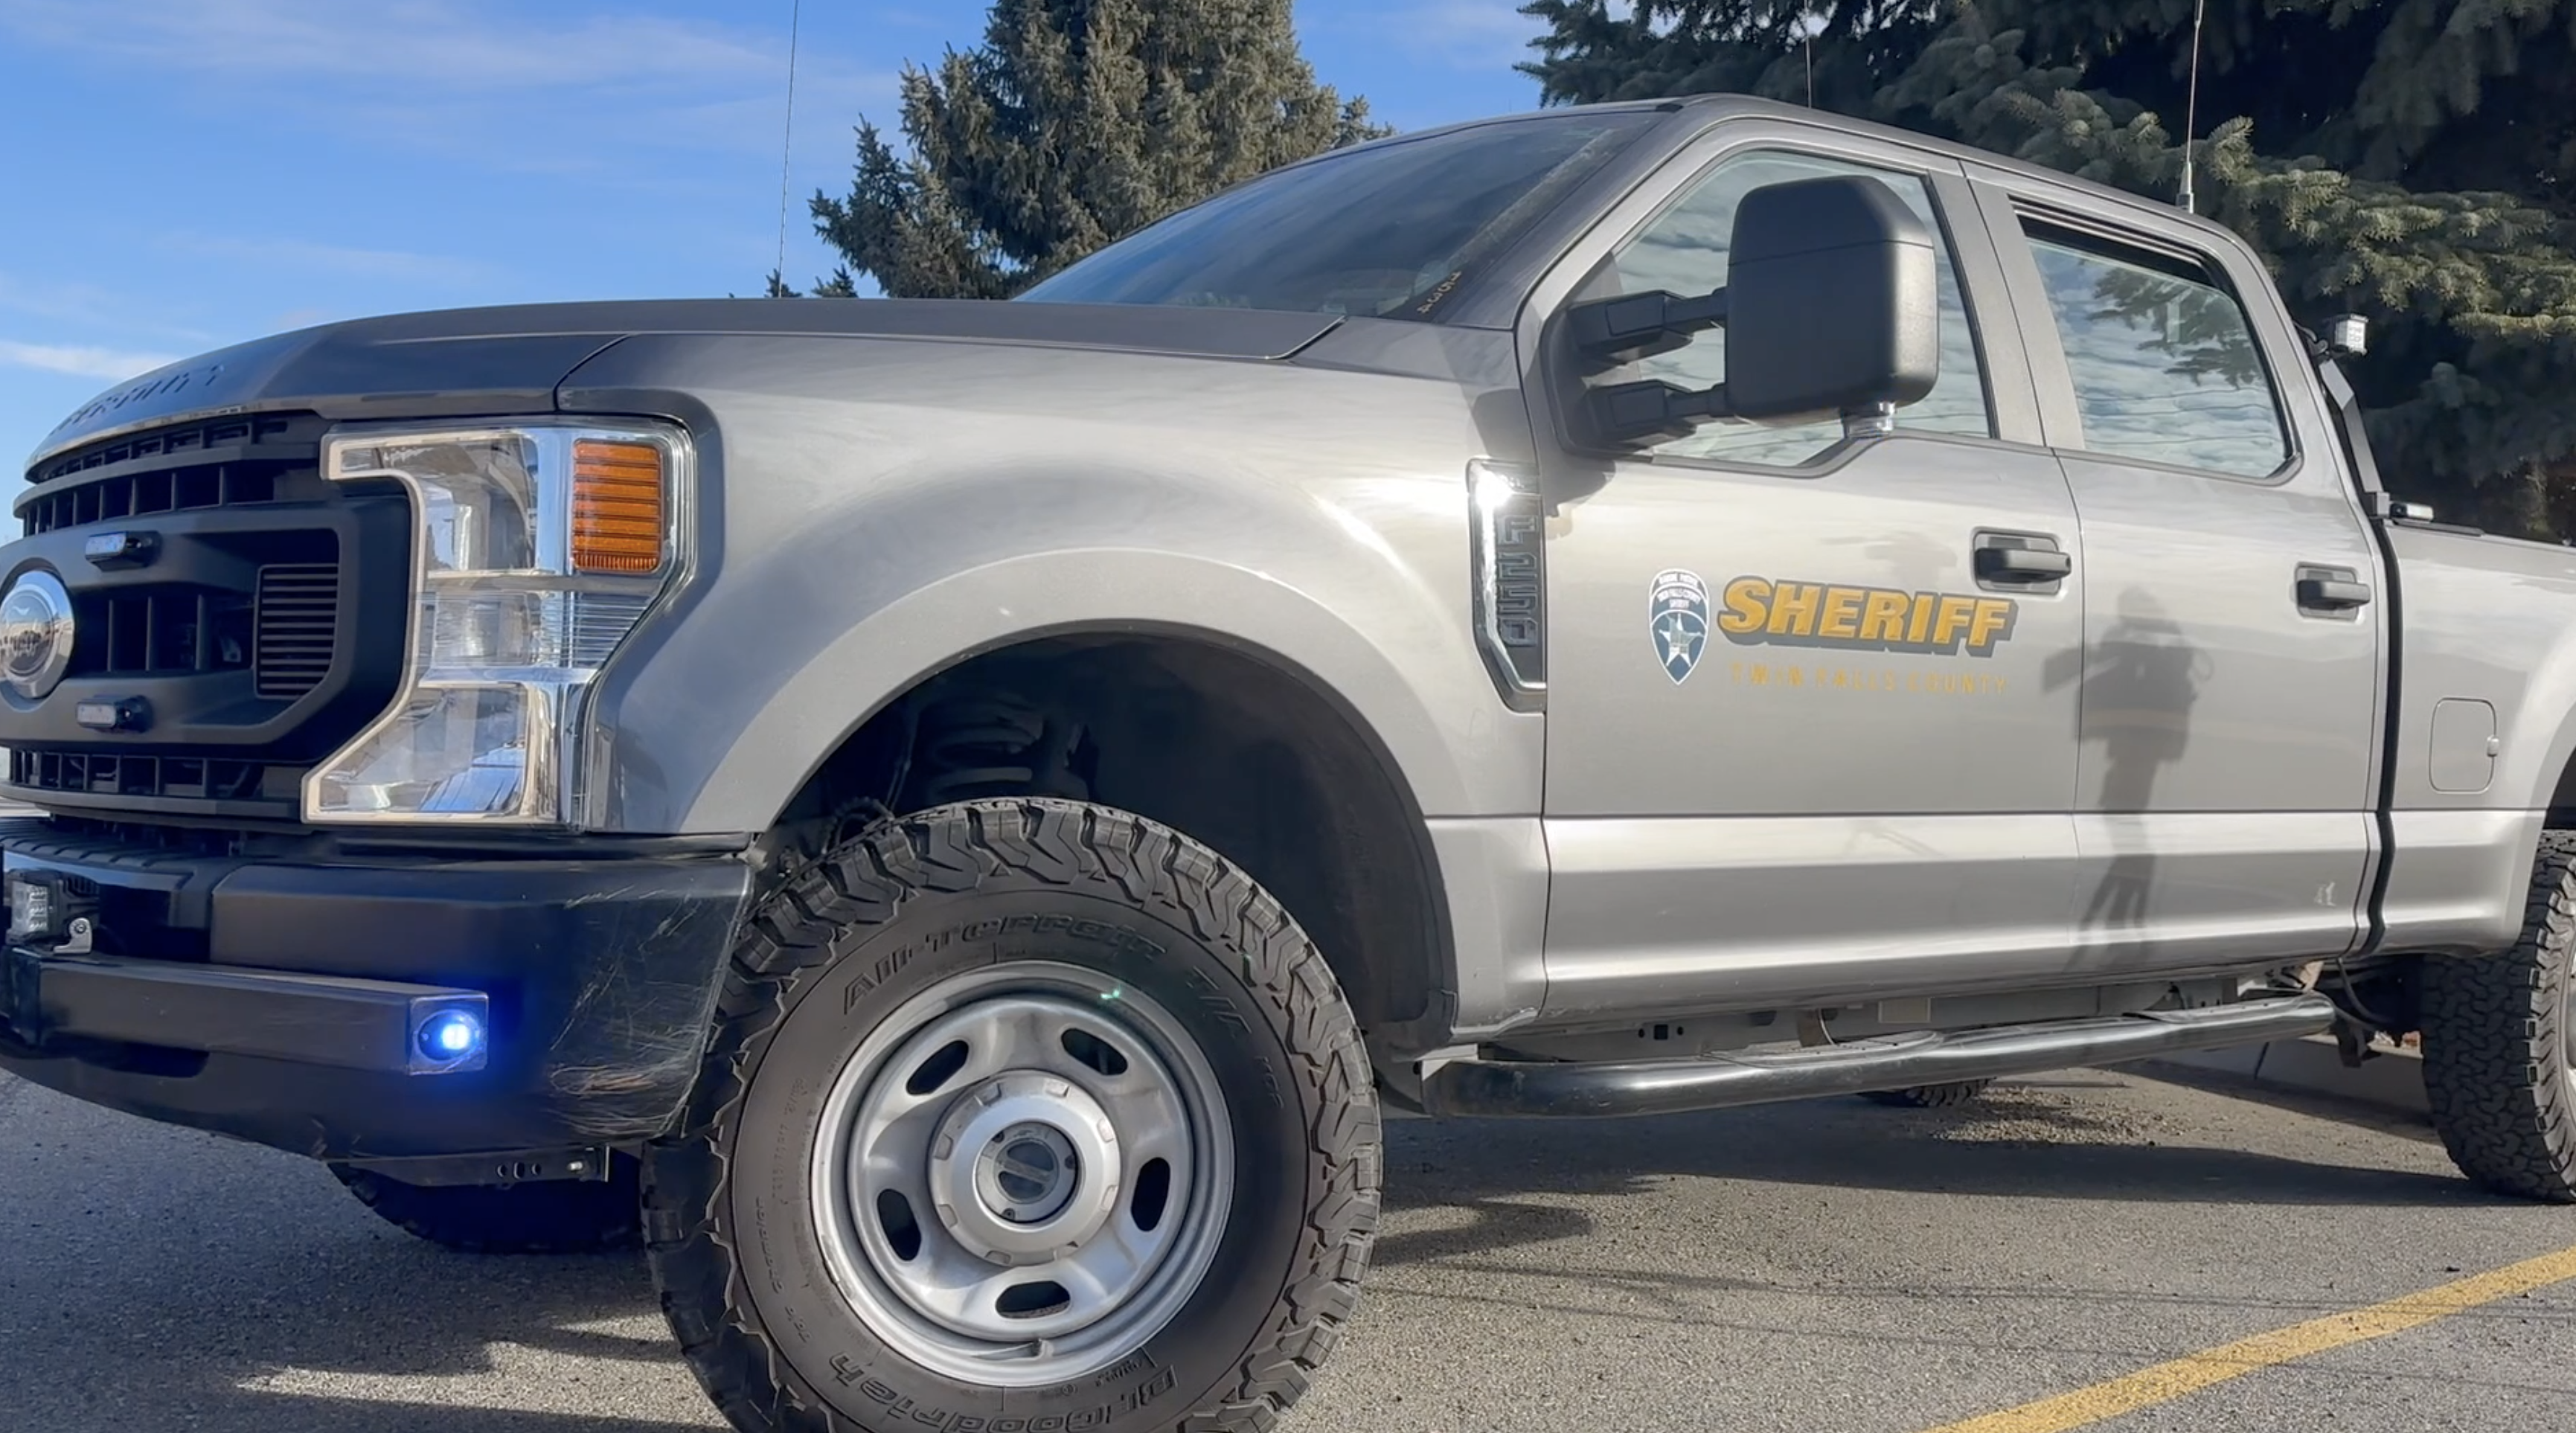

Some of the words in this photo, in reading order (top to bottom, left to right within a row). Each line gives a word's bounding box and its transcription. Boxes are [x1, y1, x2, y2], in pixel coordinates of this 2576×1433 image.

[1496, 513, 1539, 647] F250
[1717, 576, 2017, 656] SHERIFF
[1731, 661, 1804, 687] TWIN
[1815, 668, 1895, 693] FALLS
[1907, 671, 2008, 695] COUNTY
